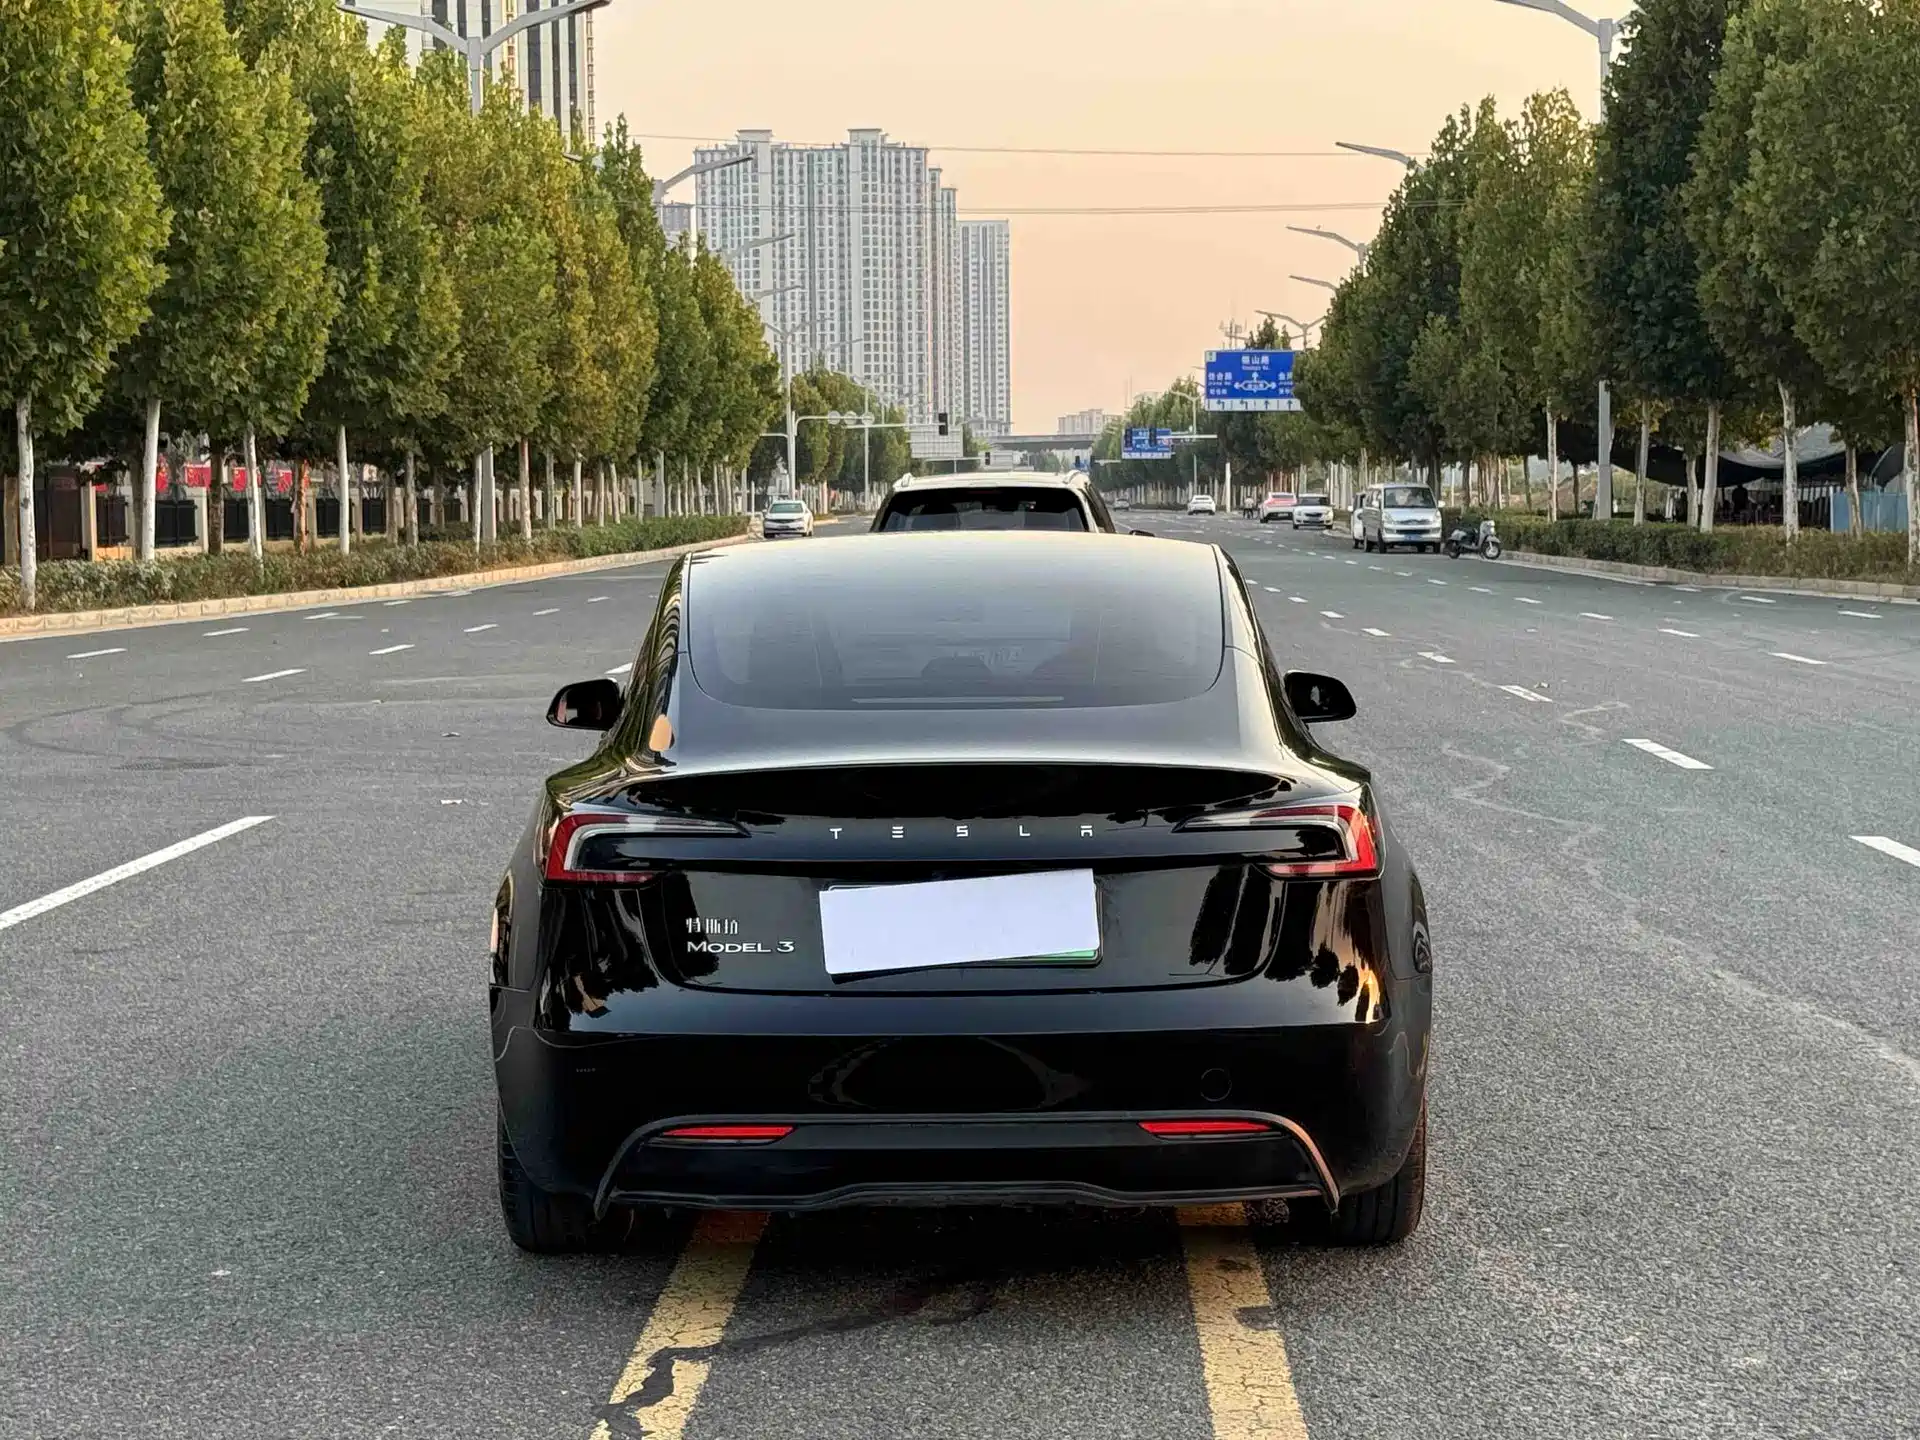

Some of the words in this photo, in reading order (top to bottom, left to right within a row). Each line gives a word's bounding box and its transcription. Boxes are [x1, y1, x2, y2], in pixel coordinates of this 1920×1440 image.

[829, 825, 1093, 840] TESLA
[685, 917, 738, 935] 特斯拉
[776, 940, 796, 954] 3
